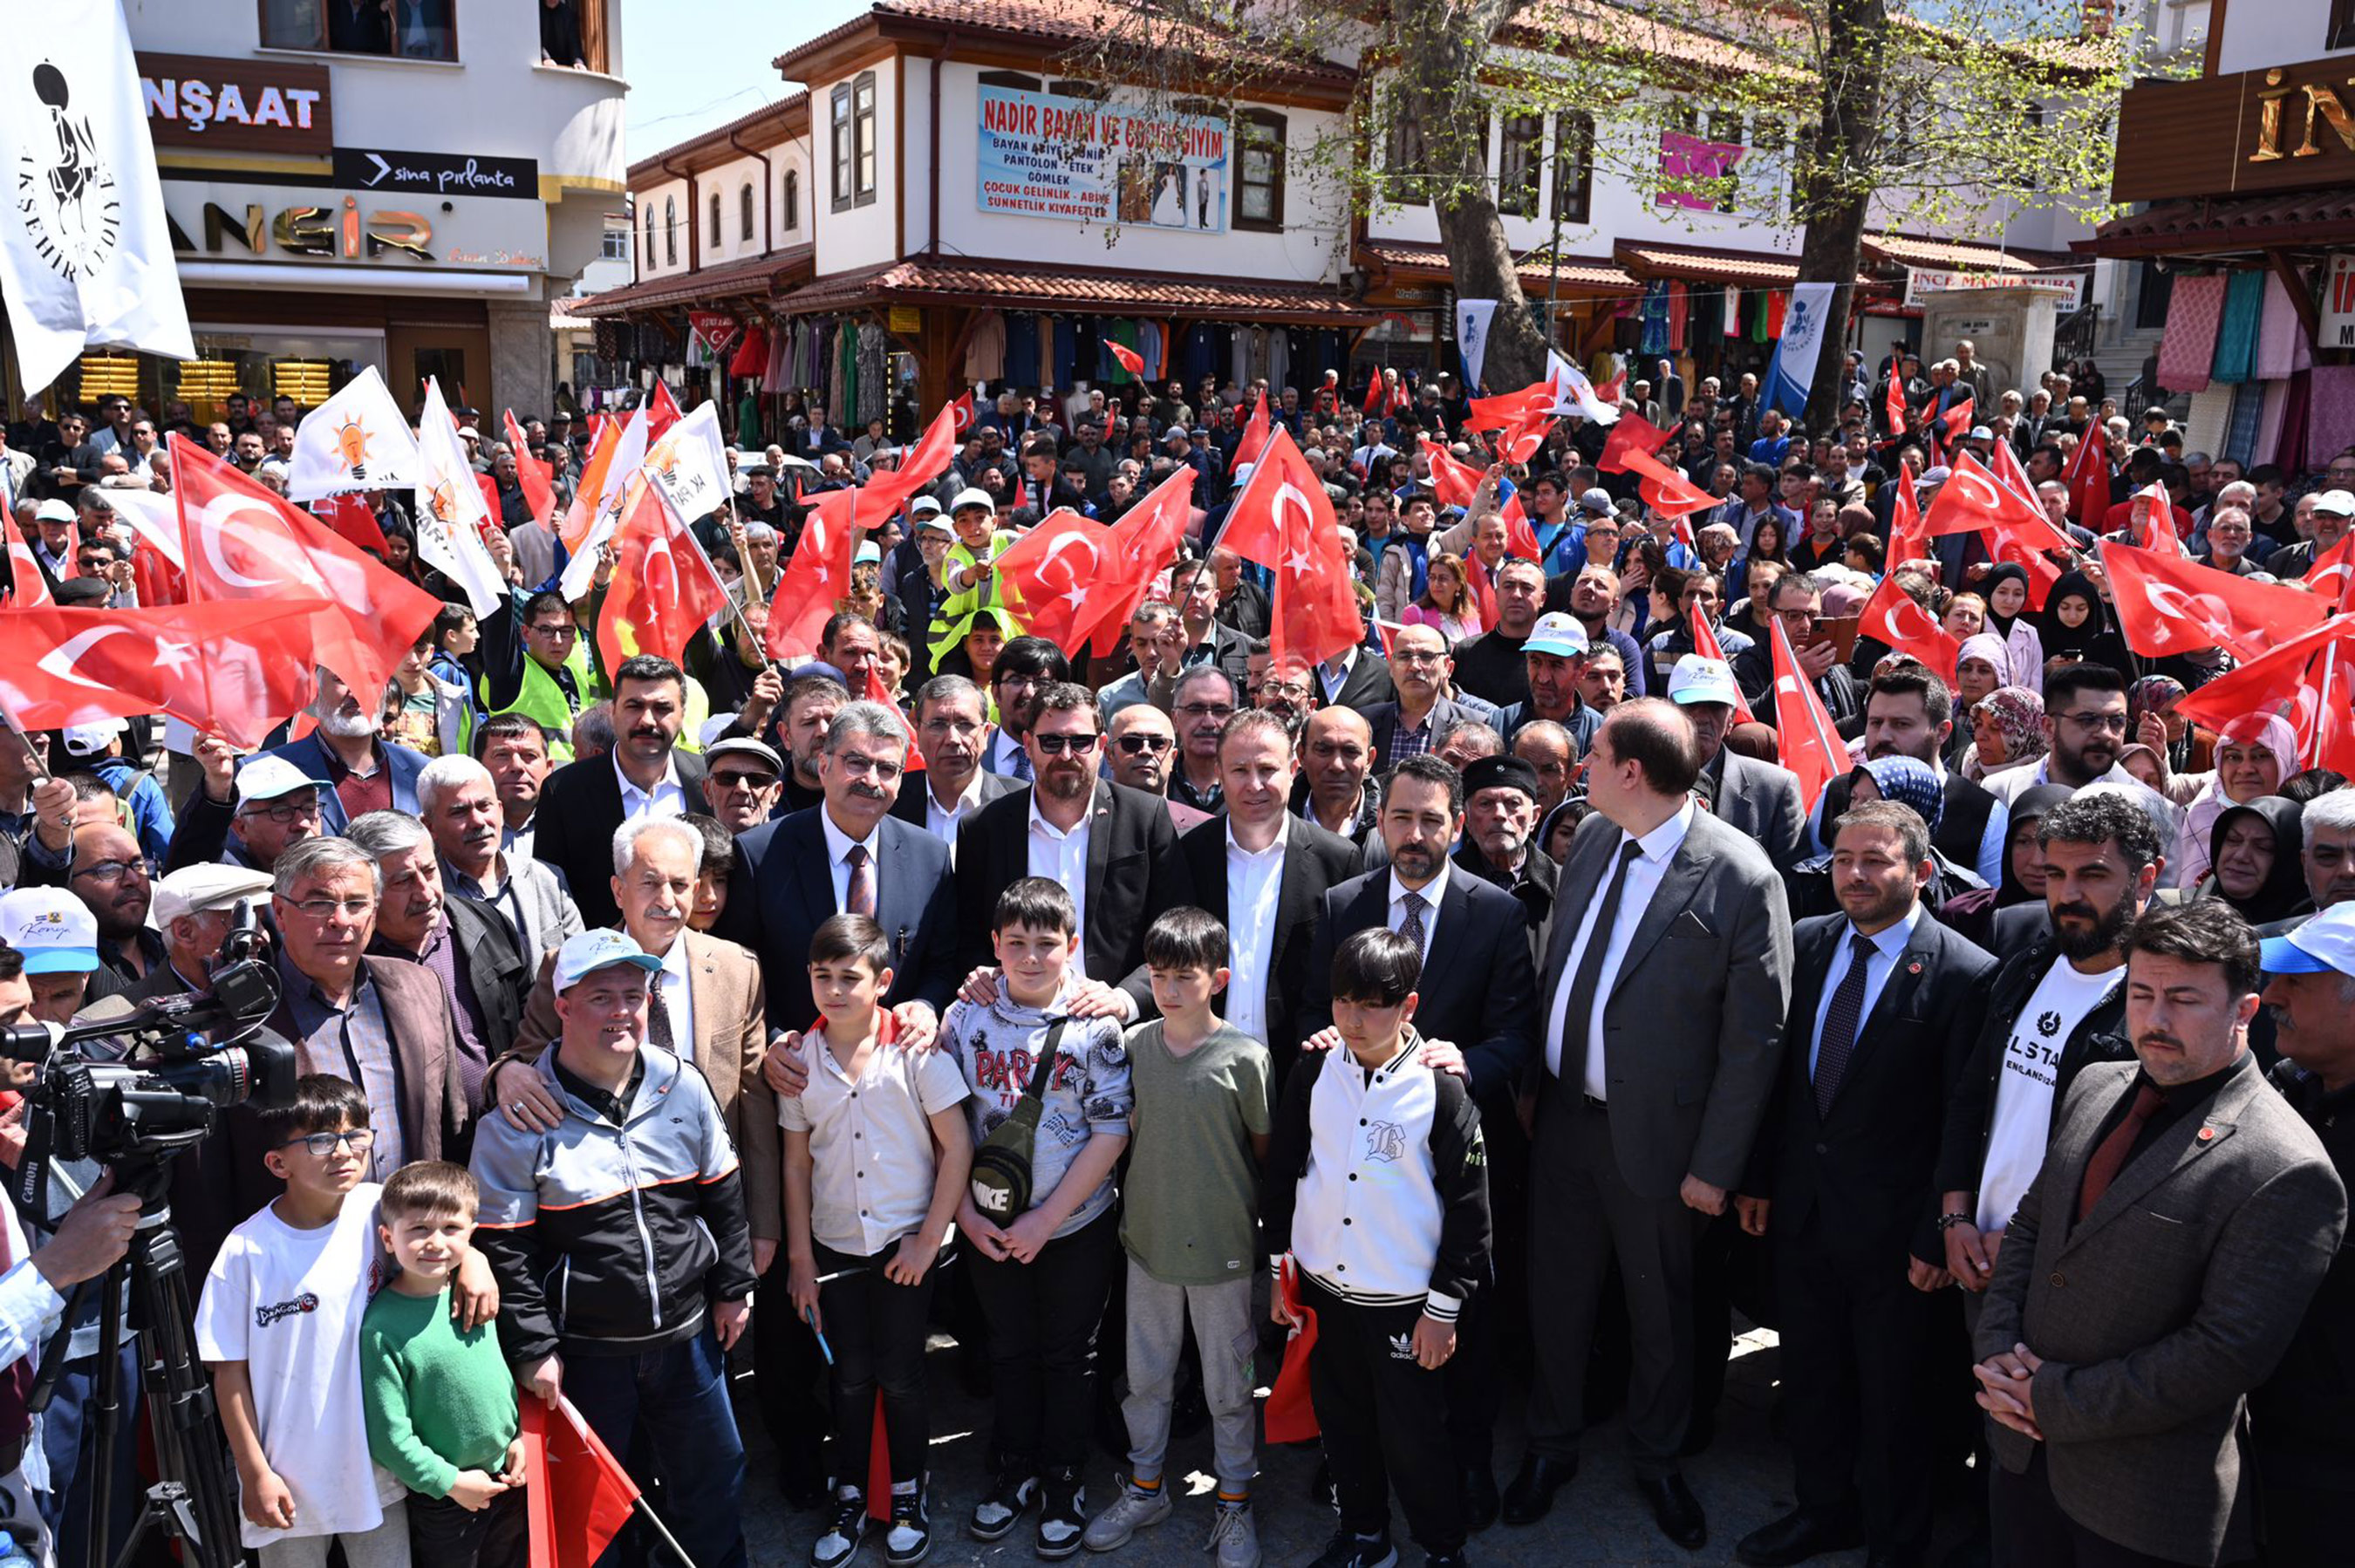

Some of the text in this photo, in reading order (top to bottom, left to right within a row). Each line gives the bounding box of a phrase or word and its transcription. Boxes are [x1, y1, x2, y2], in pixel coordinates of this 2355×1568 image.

[984, 95, 1037, 135] NADİR
[1043, 107, 1096, 143] BAYAN
[1102, 114, 1121, 146] VE
[993, 138, 1027, 152] BAYAN
[394, 157, 515, 193] sina pırlanta
[1004, 153, 1058, 170] PANTOLON
[1069, 162, 1094, 174] ETEK
[1028, 169, 1070, 185] GÖMLEK
[984, 181, 1020, 194] ÇOCUK
[1023, 184, 1070, 200] GELİNLİK
[1081, 190, 1110, 205] ABİYE
[987, 194, 1108, 218] SÜNNETLİK KIYAFETLER
[19, 921, 71, 940] Konya
[22, 1161, 39, 1204] Canon
[972, 1178, 1010, 1212] NIKE
